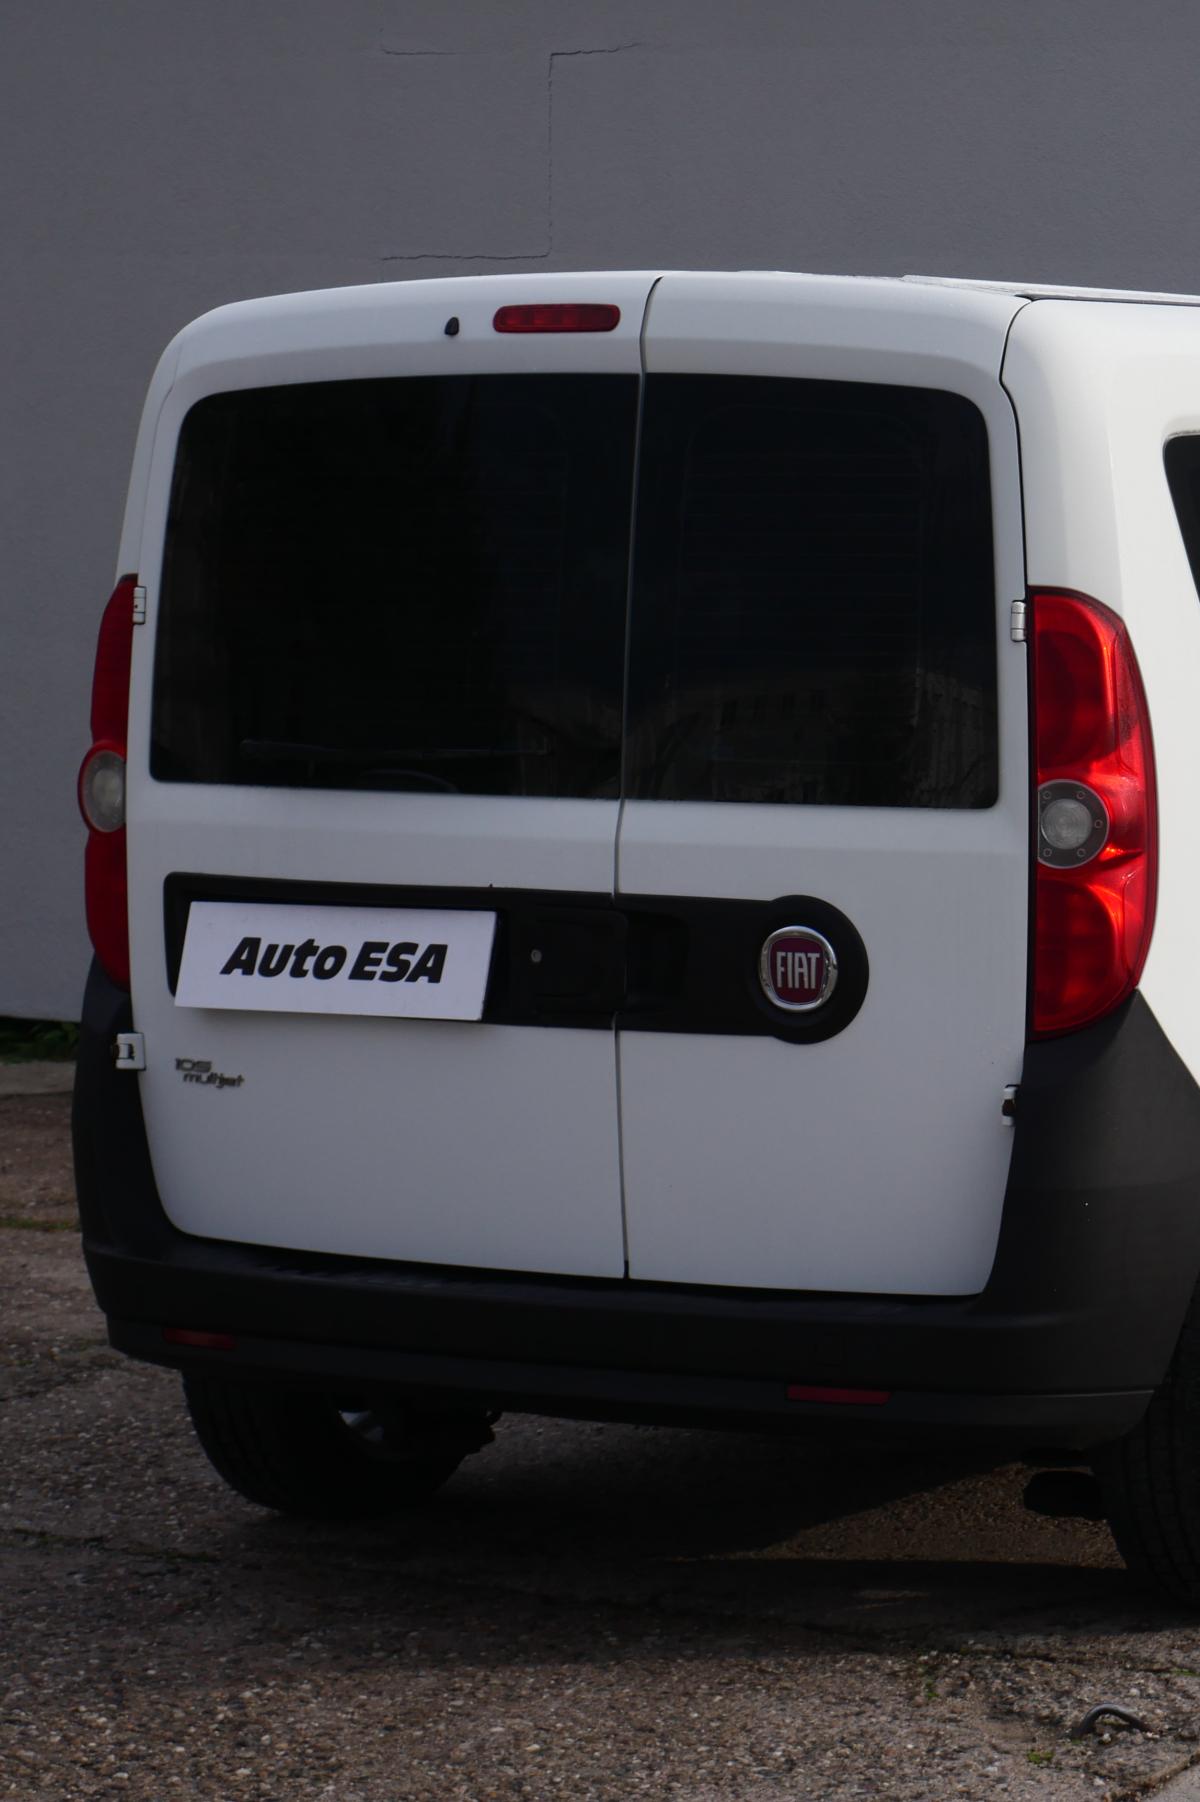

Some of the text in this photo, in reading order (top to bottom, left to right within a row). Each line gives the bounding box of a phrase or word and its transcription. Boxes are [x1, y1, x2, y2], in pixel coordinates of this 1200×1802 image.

[219, 937, 448, 984] Auto ESA
[776, 951, 820, 989] FIAT
